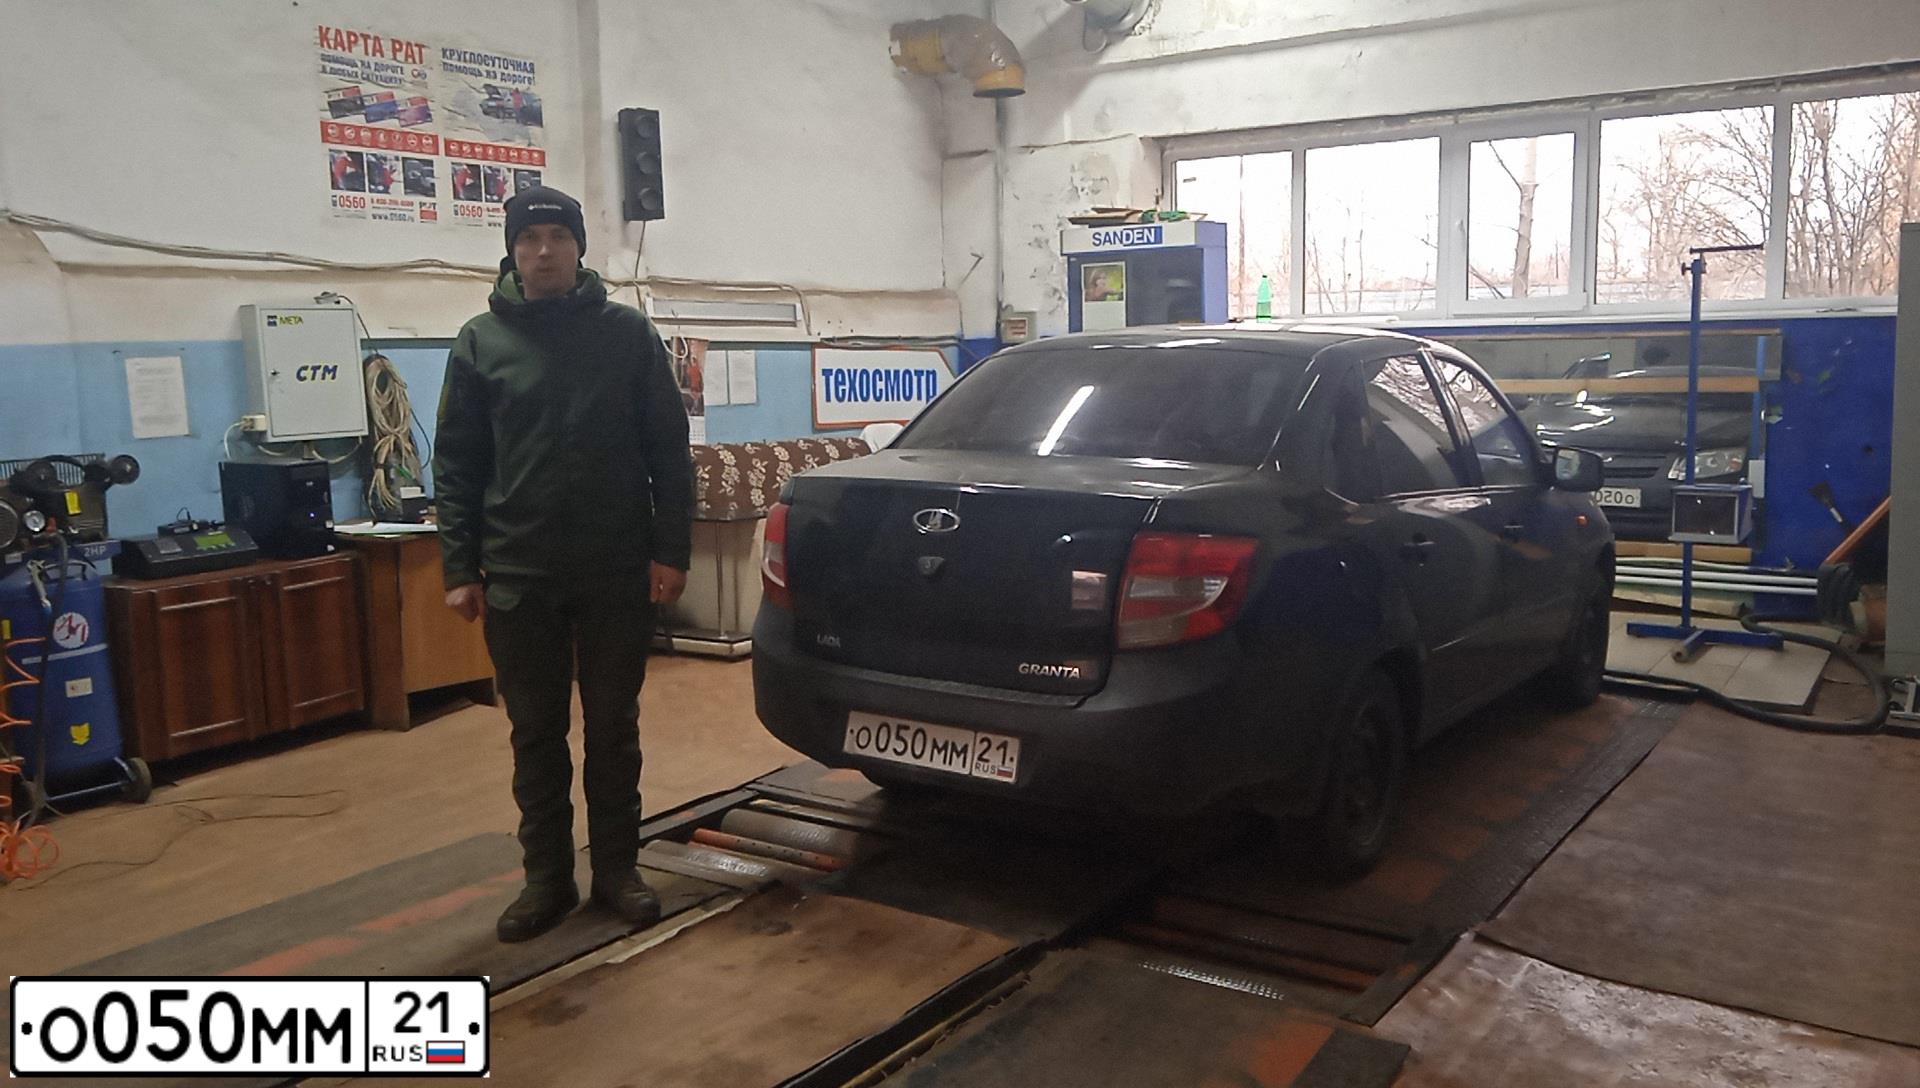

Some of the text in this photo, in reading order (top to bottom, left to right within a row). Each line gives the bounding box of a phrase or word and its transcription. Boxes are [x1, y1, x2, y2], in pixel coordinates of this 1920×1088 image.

[318, 25, 426, 64] КАРТА РАТ
[441, 48, 535, 73] КРУГЛОСУТОЧНАЯ
[339, 195, 366, 209] 0560
[459, 204, 483, 217] 0560
[1092, 228, 1155, 247] SANDEN
[84, 545, 107, 557] 2HP
[1018, 662, 1081, 679] GRANTA
[855, 722, 1010, 769] О050ММ 21
[974, 762, 997, 775] RUS
